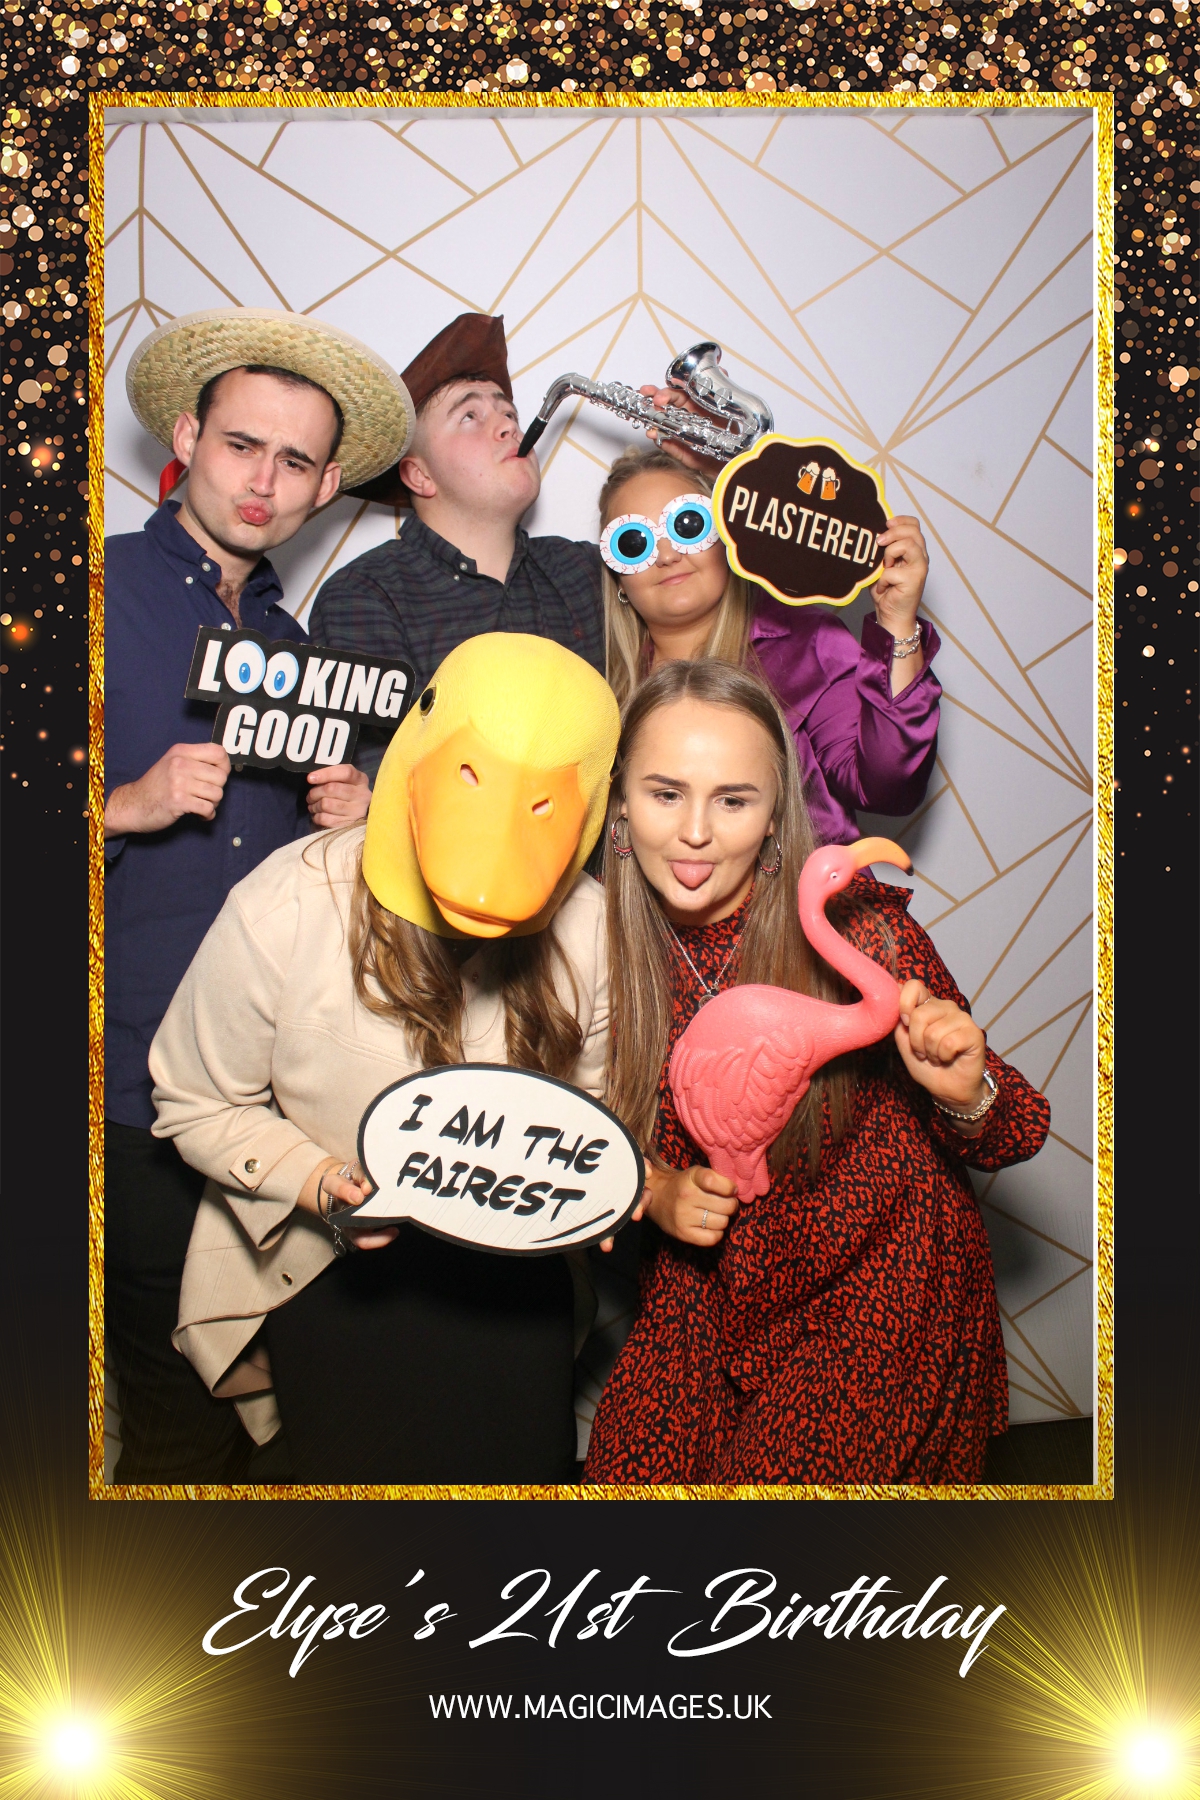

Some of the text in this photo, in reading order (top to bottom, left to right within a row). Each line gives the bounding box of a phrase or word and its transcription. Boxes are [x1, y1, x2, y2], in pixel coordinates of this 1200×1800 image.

[728, 485, 880, 568] PLASTERED!
[198, 640, 408, 719] LOOKING
[222, 704, 351, 766] GOOD
[398, 1094, 610, 1174] I AM THE
[397, 1151, 586, 1222] FAIREST
